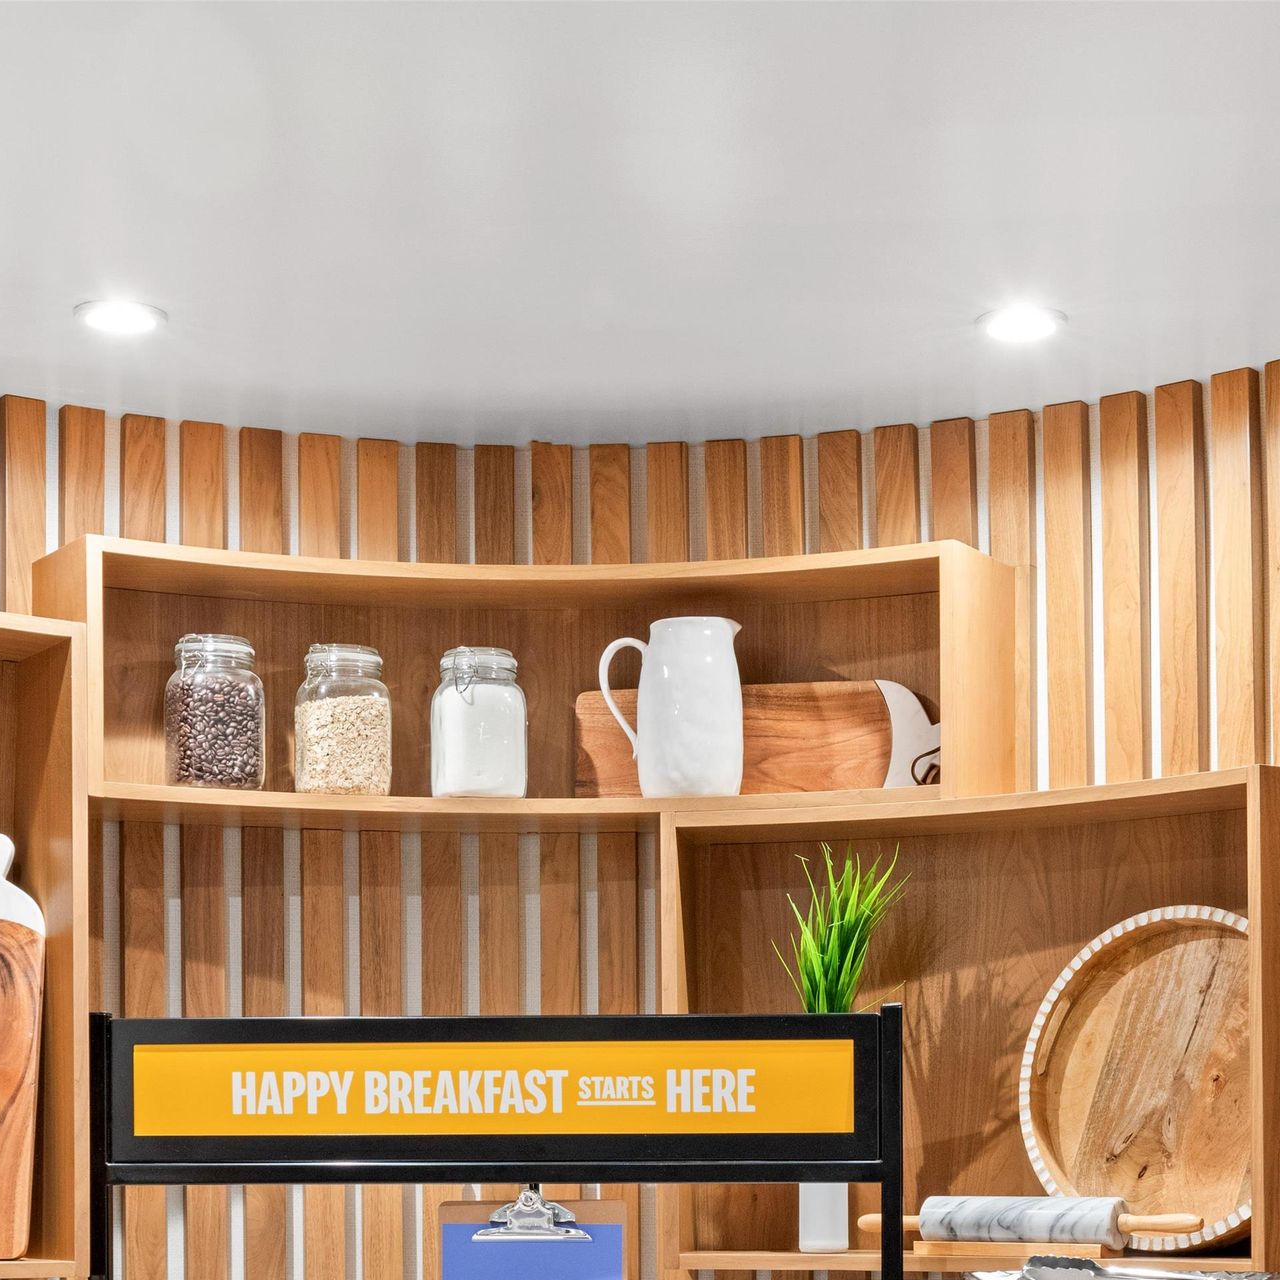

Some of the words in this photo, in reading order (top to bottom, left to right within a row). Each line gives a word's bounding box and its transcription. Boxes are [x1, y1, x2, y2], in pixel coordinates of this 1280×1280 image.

[232, 1071, 354, 1115] HAPPY
[365, 1069, 568, 1115] BREAKFAST
[578, 1075, 655, 1099] STARTS
[666, 1069, 756, 1113] HERE
